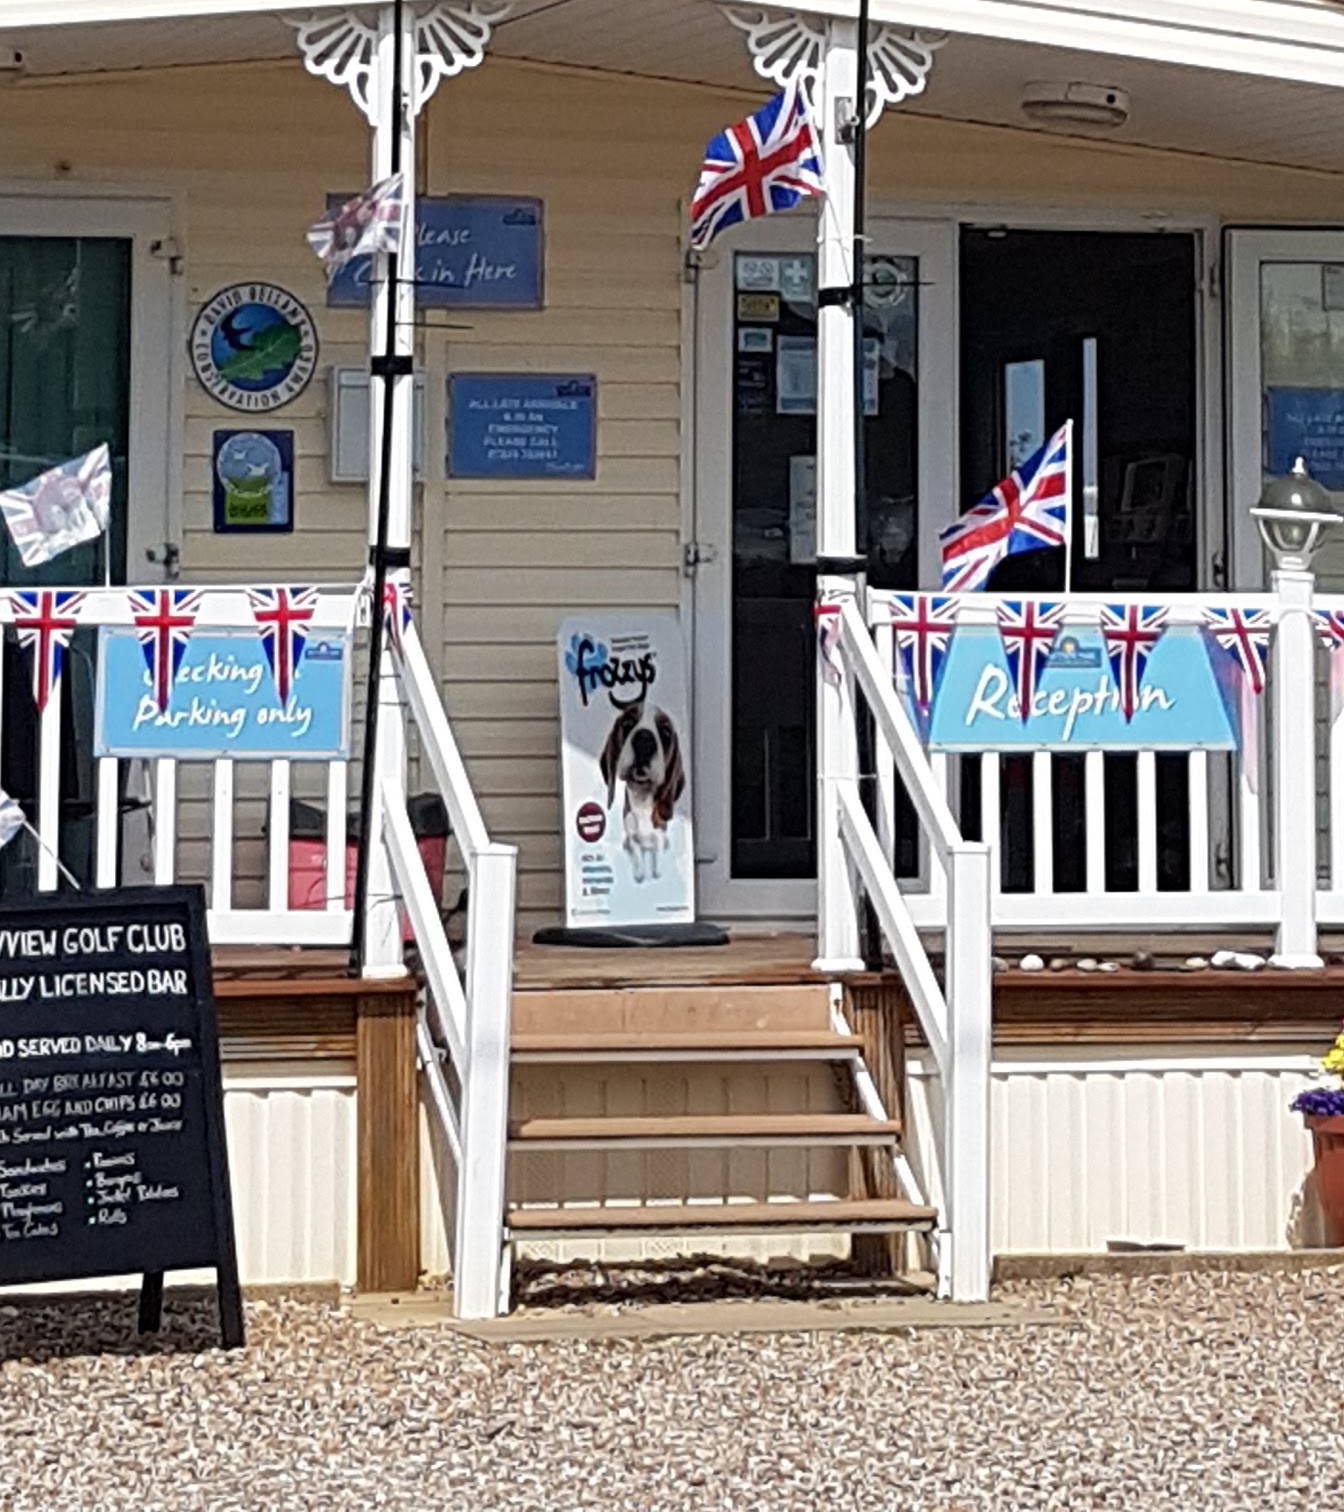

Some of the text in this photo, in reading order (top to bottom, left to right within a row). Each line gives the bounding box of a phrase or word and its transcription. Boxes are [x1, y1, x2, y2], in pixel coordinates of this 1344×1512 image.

[414, 224, 472, 246] lease
[431, 259, 455, 282] in
[464, 253, 517, 288] Here
[132, 694, 312, 739] Parking only
[63, 926, 124, 955] GOLF
[127, 923, 186, 953] CLUB
[39, 971, 144, 998] LICENSED
[147, 969, 188, 994] BAR
[17, 1038, 82, 1058] SERVED
[86, 1035, 133, 1053] DAILY
[23, 1077, 50, 1094] DAY
[53, 1071, 136, 1092] BREAKFAST
[65, 1099, 93, 1115] AND
[95, 1094, 136, 1113] CHIPS
